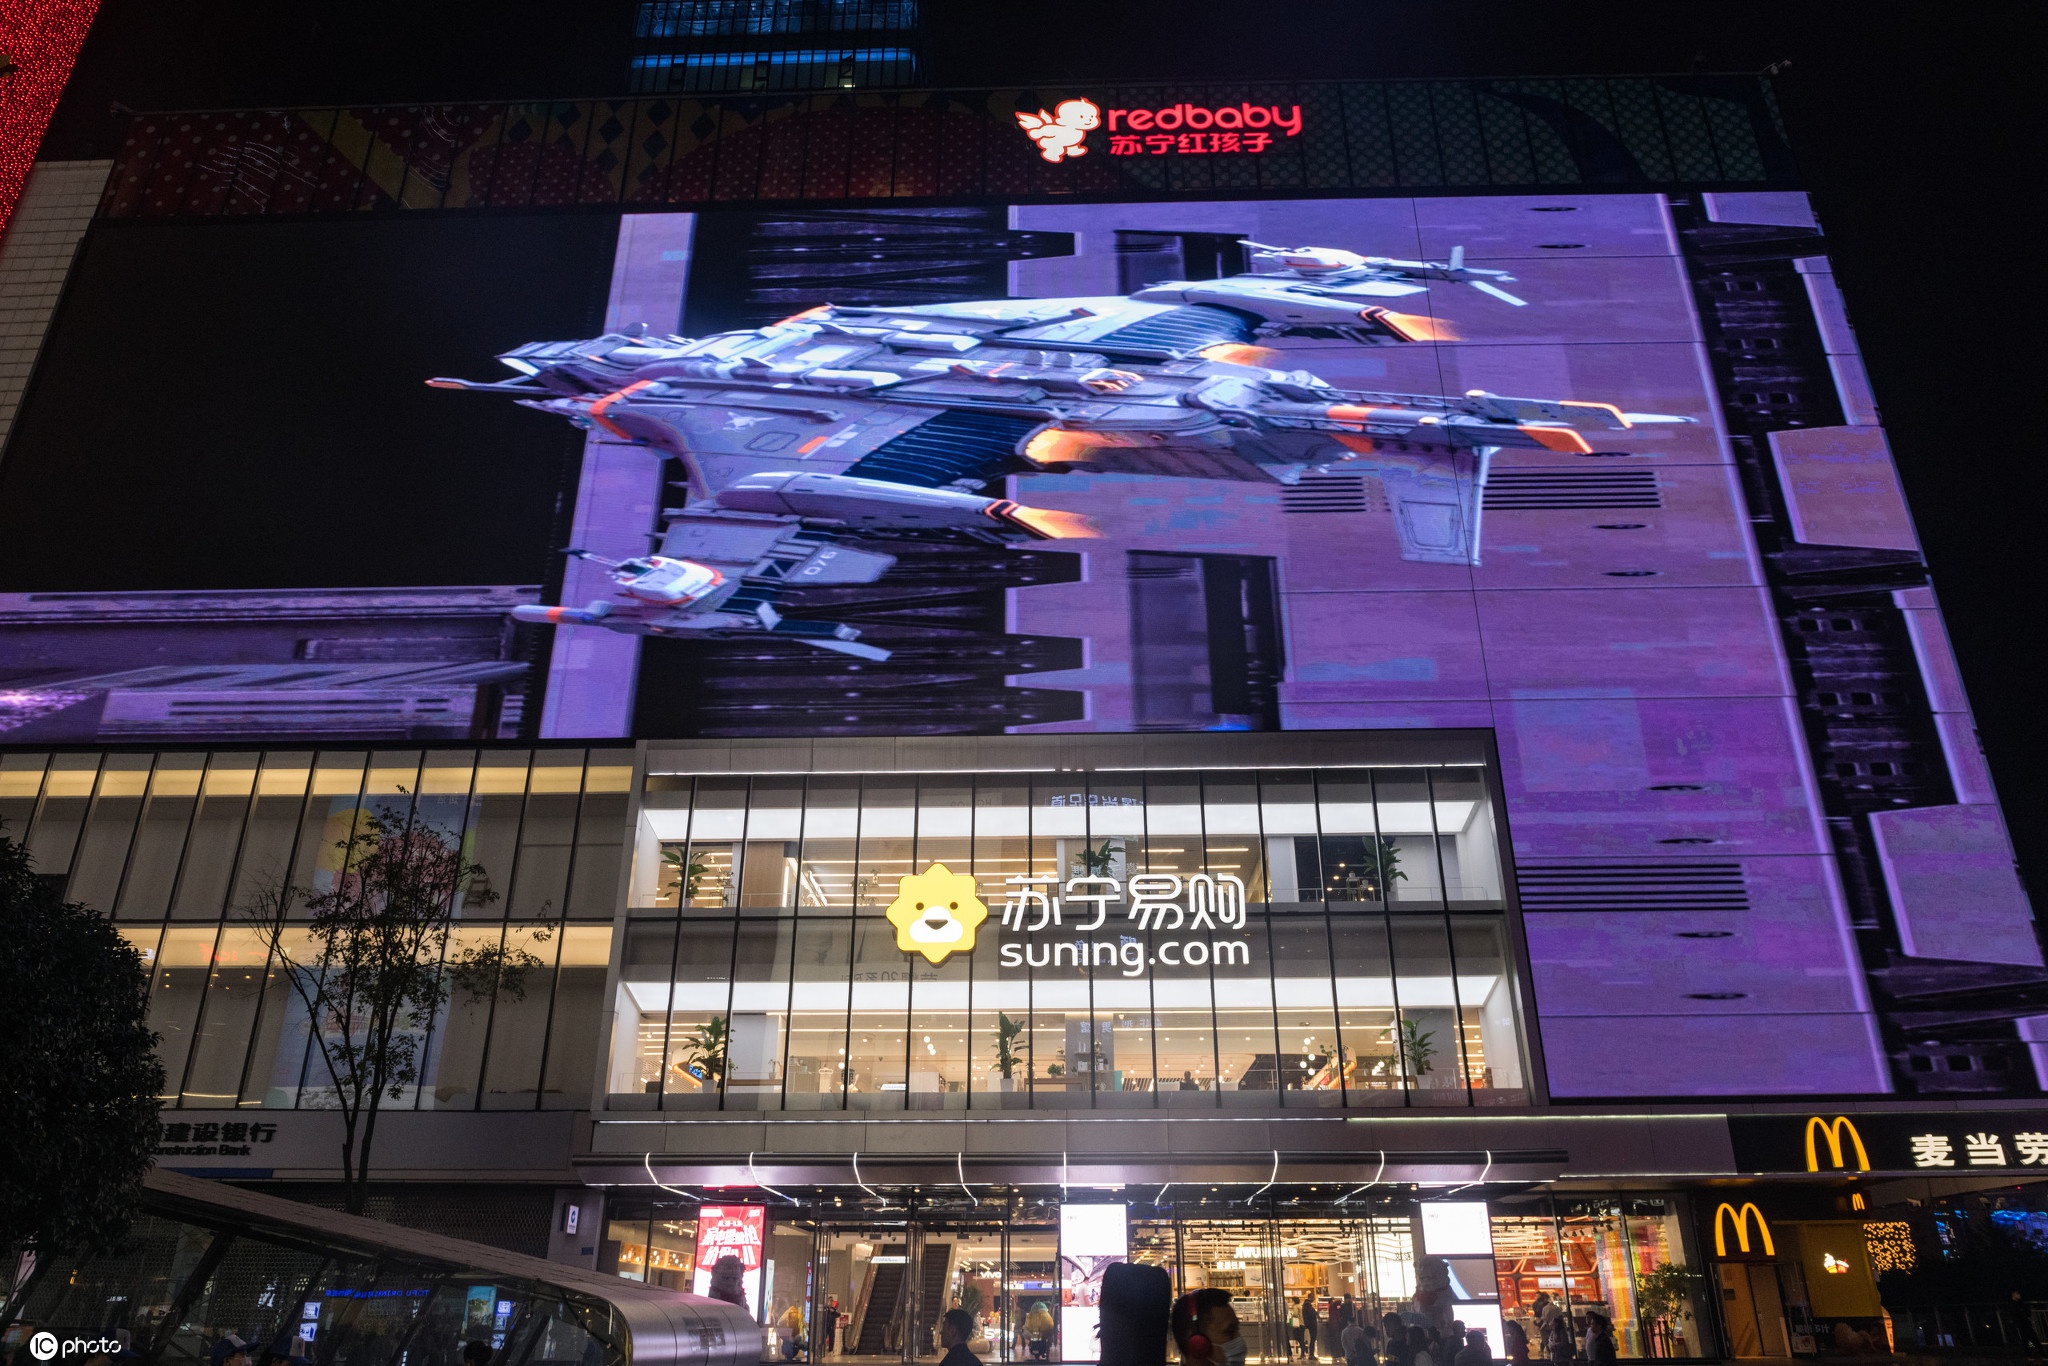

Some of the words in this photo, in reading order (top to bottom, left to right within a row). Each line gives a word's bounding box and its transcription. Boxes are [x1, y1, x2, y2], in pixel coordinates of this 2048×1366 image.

[1108, 103, 1302, 136] redbaby
[1109, 133, 1273, 155] 苏宁红孩子
[1001, 872, 1246, 931] 苏宁易购
[1000, 940, 1250, 976] suning.com
[160, 1122, 277, 1143] 建设银行
[1910, 1131, 2048, 1167] 麦当劳
